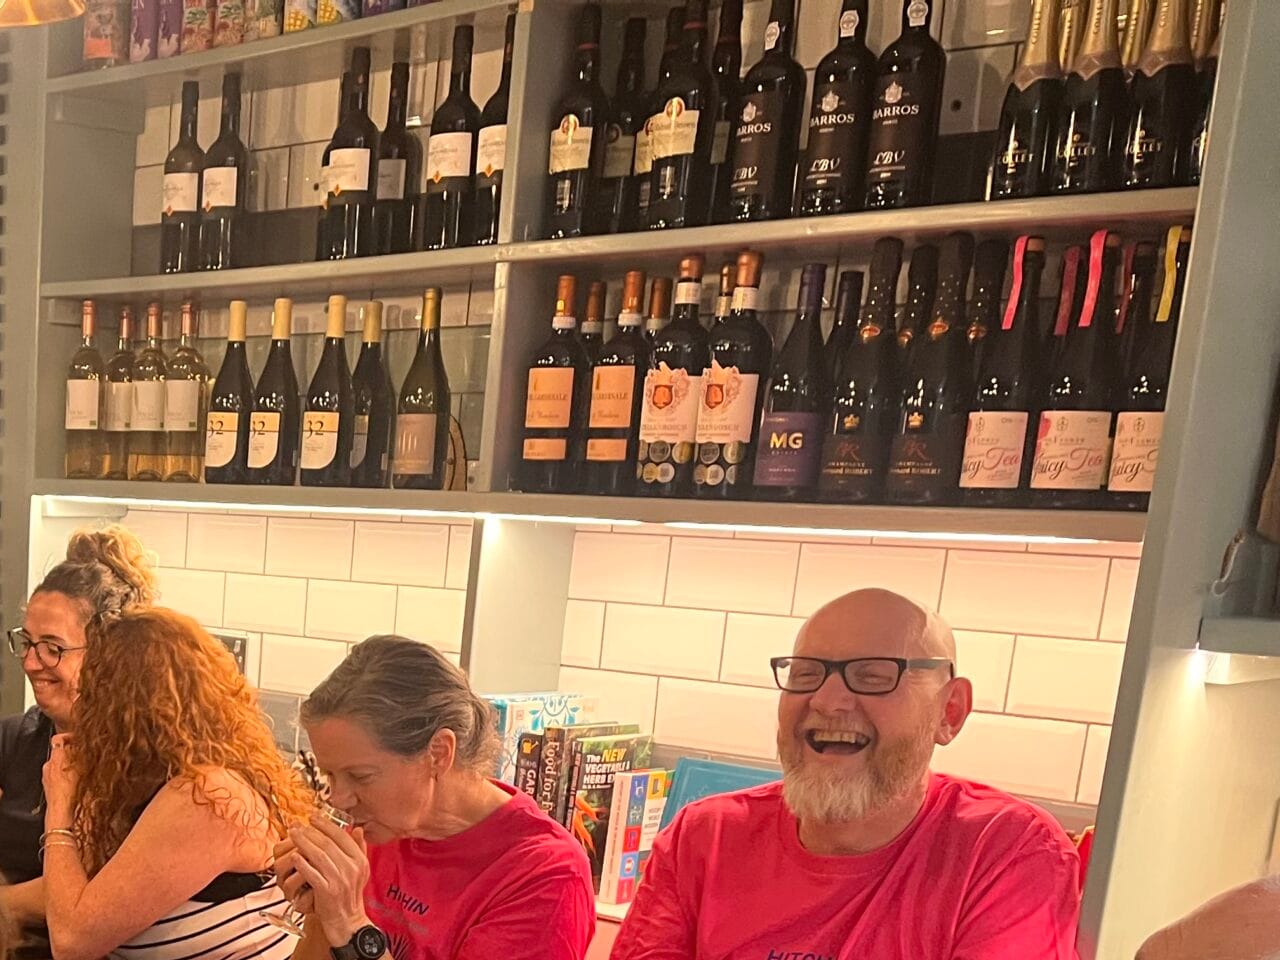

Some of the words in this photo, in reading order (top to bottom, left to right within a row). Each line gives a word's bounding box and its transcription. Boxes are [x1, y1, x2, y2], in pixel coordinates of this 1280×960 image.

[306, 420, 325, 438] 32
[770, 432, 803, 449] MG
[982, 448, 1021, 471] Tea
[545, 741, 560, 775] Food
[586, 754, 601, 764] The
[601, 748, 627, 763] NEW
[542, 777, 556, 799] for
